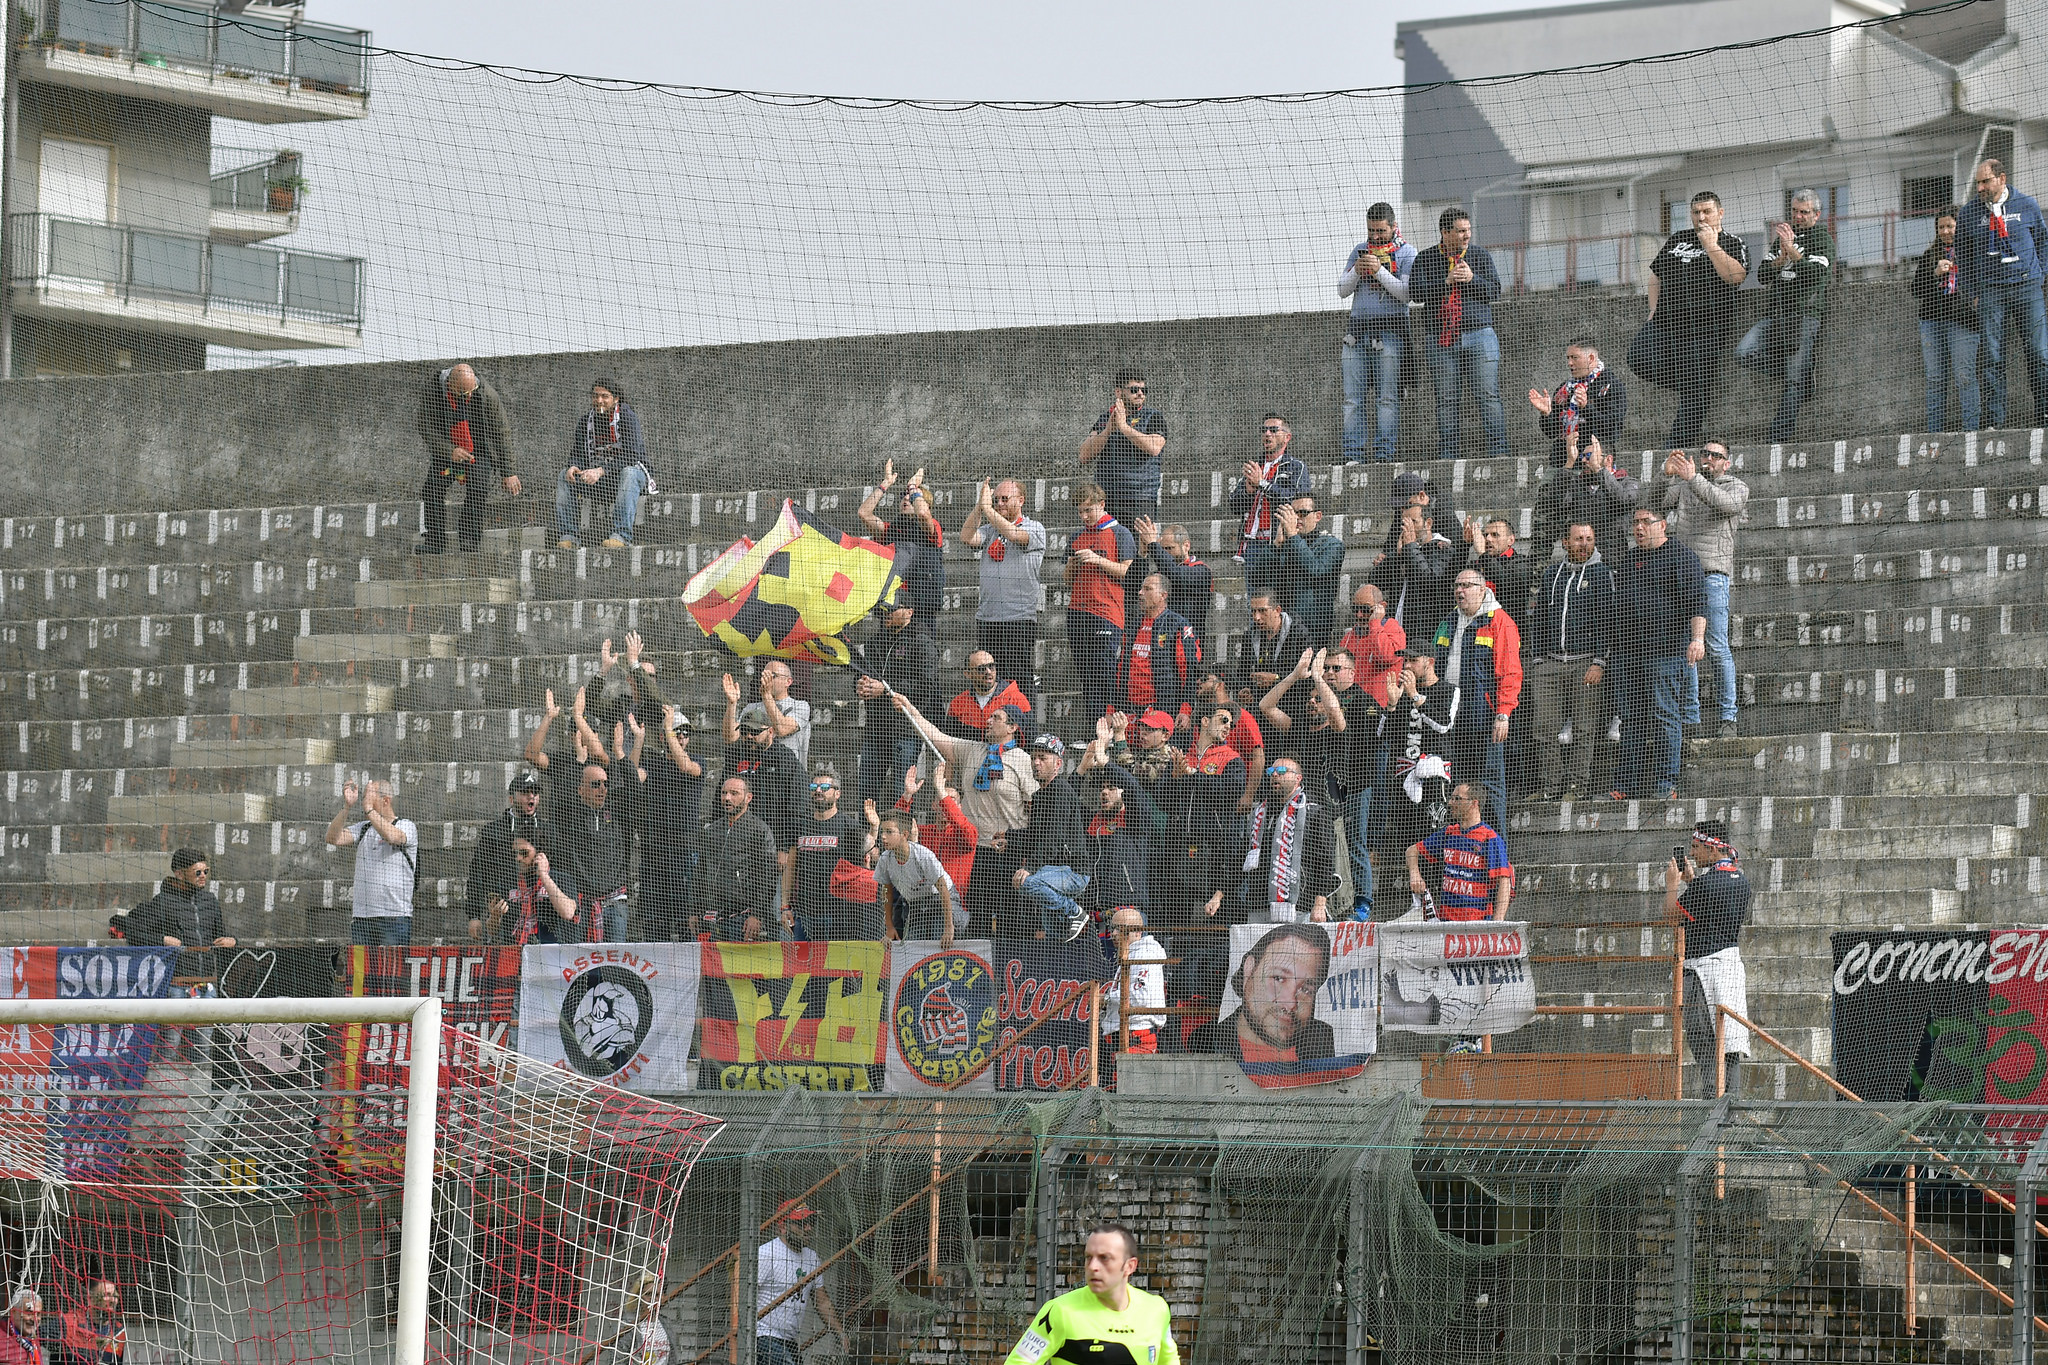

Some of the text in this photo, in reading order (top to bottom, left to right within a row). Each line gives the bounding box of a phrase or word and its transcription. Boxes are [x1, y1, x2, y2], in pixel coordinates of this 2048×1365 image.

[1444, 931, 1521, 959] CAVALLO
[61, 955, 166, 997] SOLO
[405, 957, 484, 1002] THE
[562, 951, 660, 983] ASSENTI
[1021, 1341, 1040, 1356] VITA
[1025, 1331, 1047, 1349] EURO
